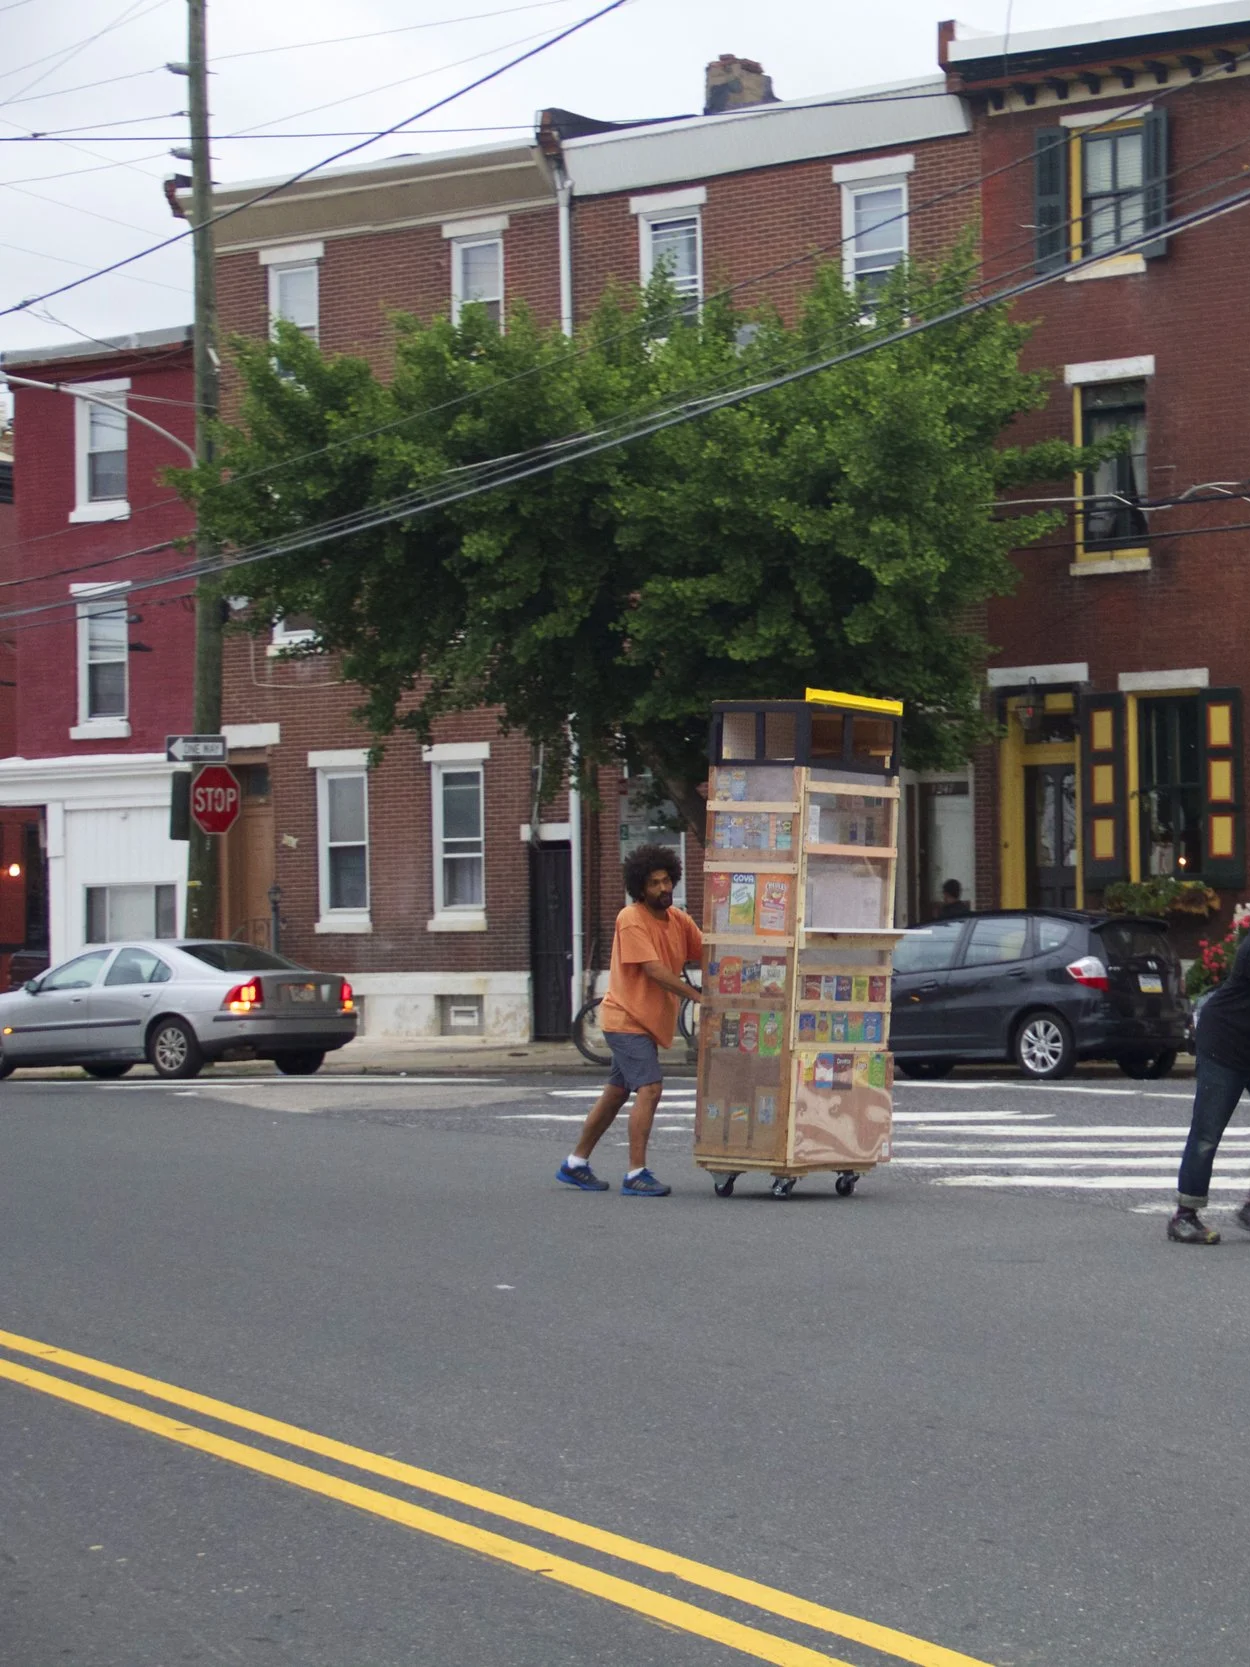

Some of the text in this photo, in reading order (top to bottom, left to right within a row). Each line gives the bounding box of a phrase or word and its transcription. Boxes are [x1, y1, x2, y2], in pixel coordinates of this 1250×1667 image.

[184, 743, 220, 753] ONE WAY
[195, 787, 236, 812] STOP
[733, 874, 754, 882] GOYA
